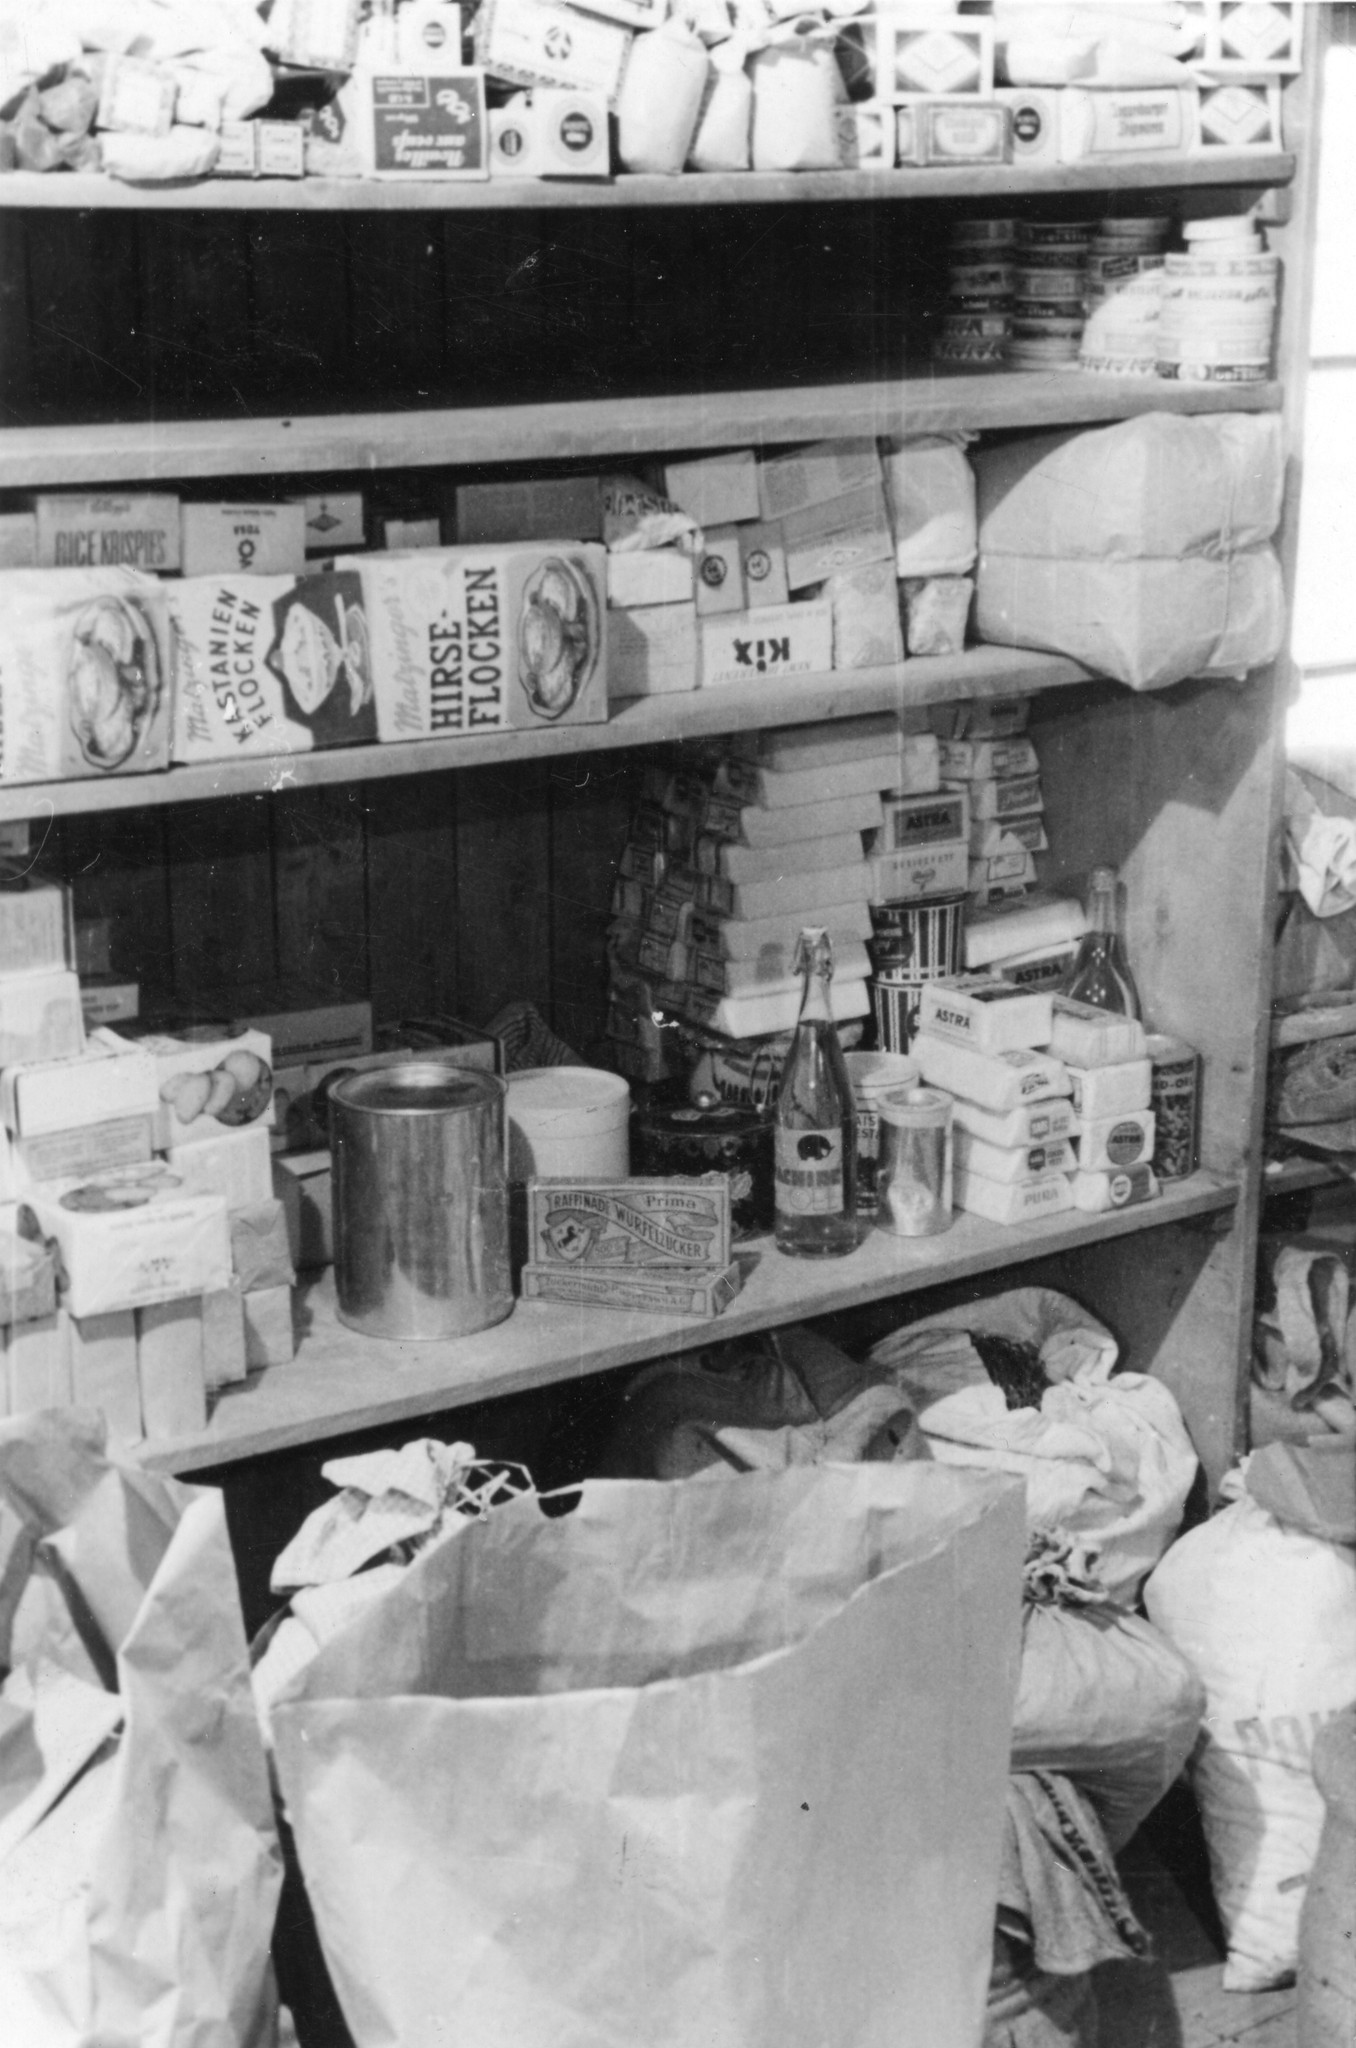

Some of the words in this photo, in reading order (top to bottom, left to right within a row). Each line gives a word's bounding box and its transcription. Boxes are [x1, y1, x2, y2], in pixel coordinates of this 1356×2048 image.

[56, 529, 96, 566] RICE
[99, 528, 167, 566] KRISPIES
[208, 589, 254, 745] KASTANIEN
[233, 600, 273, 729] FLOCKEN
[429, 608, 463, 731] HIRSE-
[464, 566, 502, 728] FLOCKEN
[1015, 963, 1062, 985] ASTRA
[935, 1008, 971, 1030] ASTRA
[645, 1194, 697, 1209] Prima
